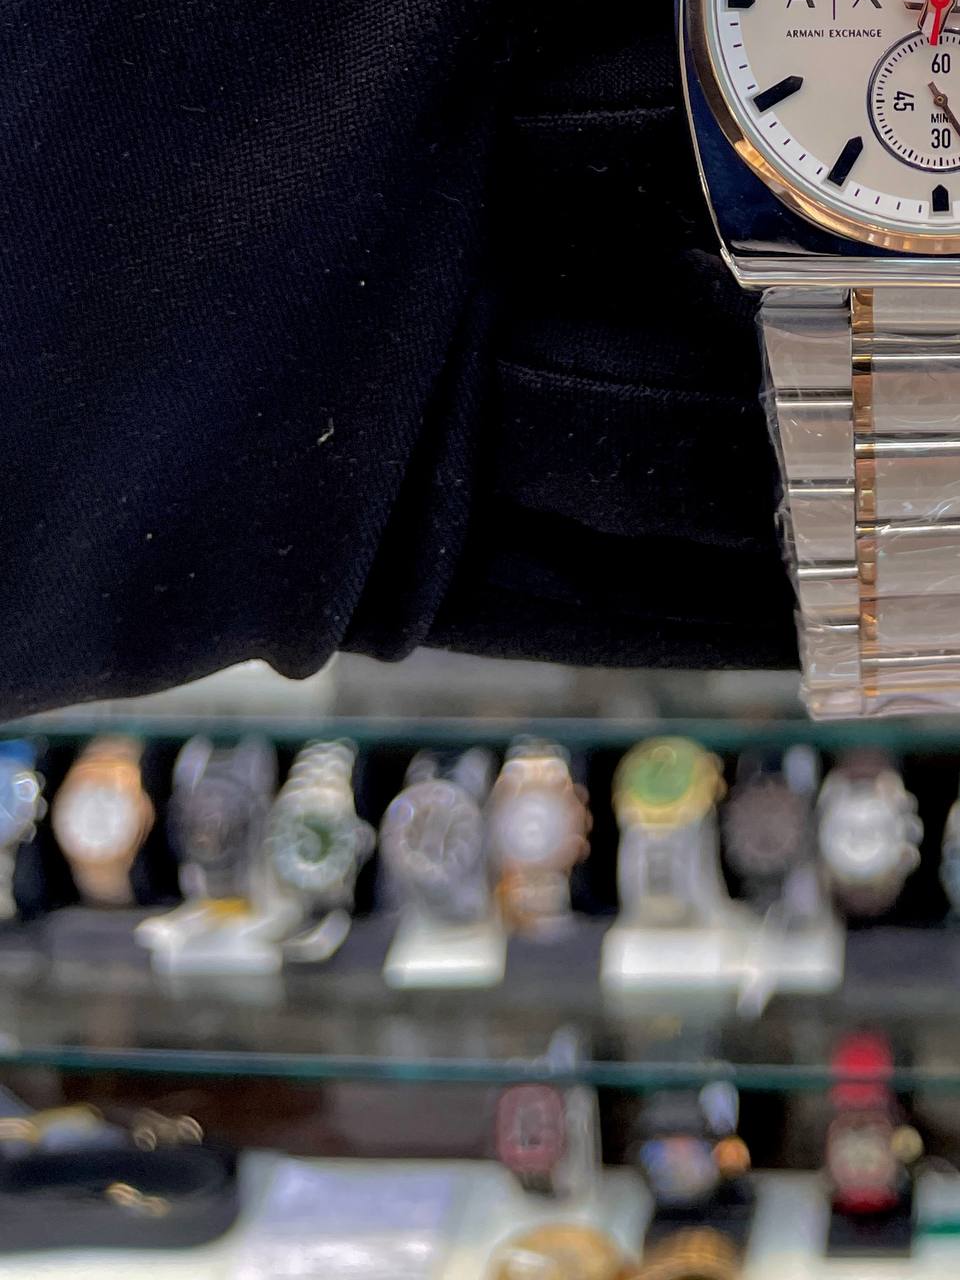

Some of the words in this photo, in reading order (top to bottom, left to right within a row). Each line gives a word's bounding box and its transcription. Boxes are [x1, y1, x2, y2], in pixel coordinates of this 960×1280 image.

[785, 29, 824, 38] ARMANI
[828, 28, 882, 38] EXCHANGE
[931, 53, 951, 74] 60
[893, 91, 915, 112] 45
[930, 128, 951, 149] 30
